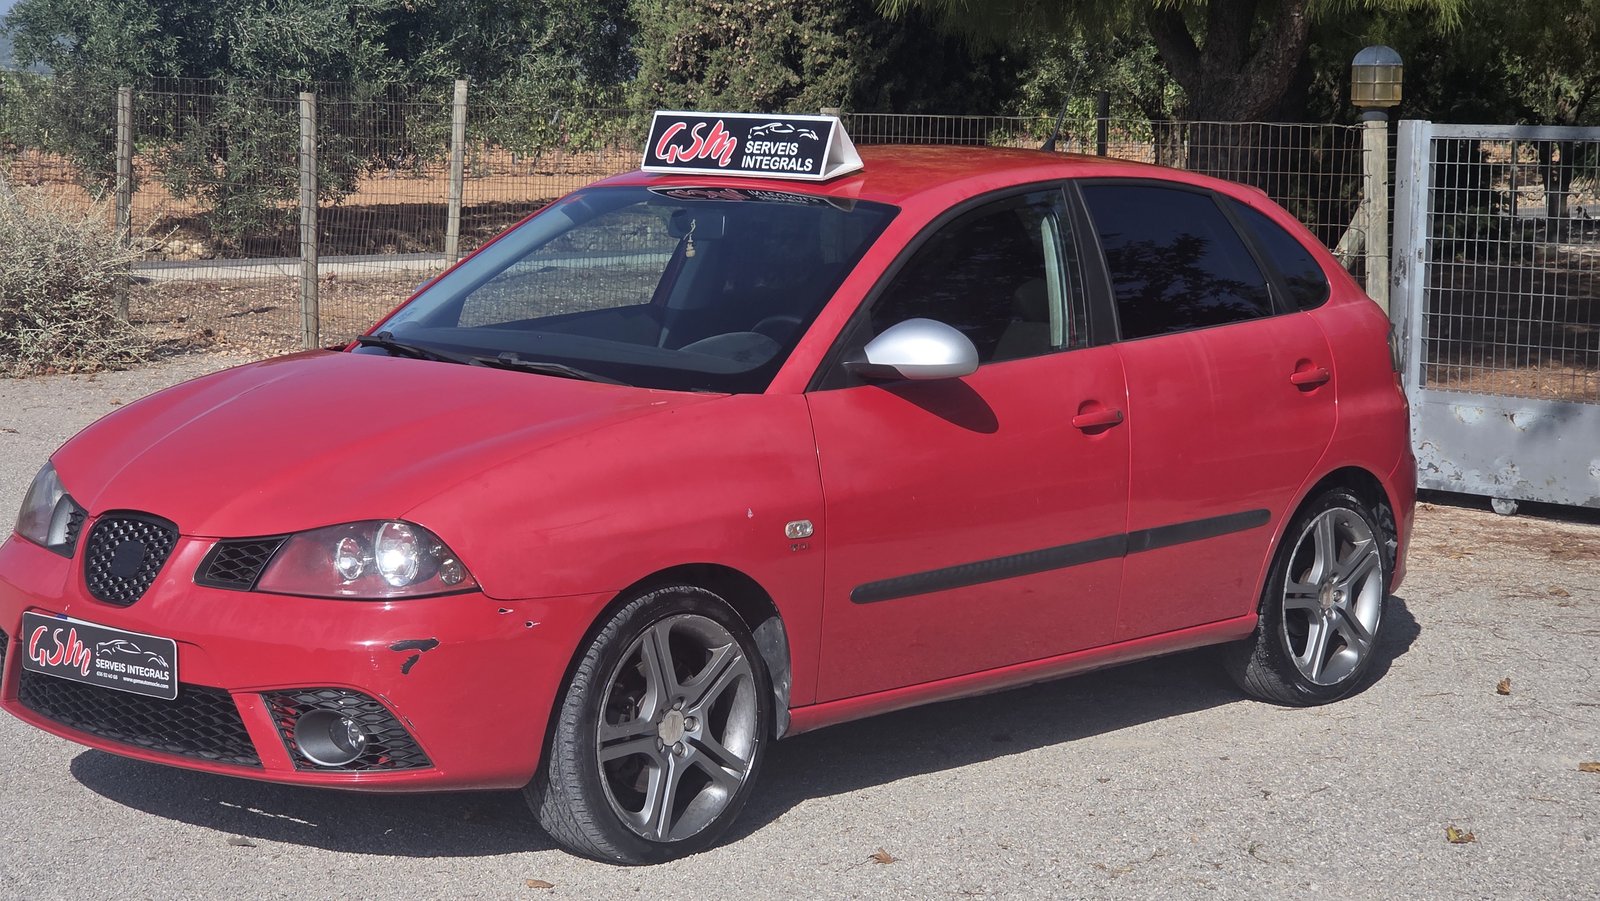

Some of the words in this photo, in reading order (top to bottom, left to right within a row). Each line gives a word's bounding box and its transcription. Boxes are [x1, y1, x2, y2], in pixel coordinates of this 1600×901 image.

[745, 141, 798, 155] SERVEIS
[741, 154, 813, 172] INTEGRALS
[95, 658, 126, 673] SERVEIS
[127, 664, 169, 680] INTEGRALS
